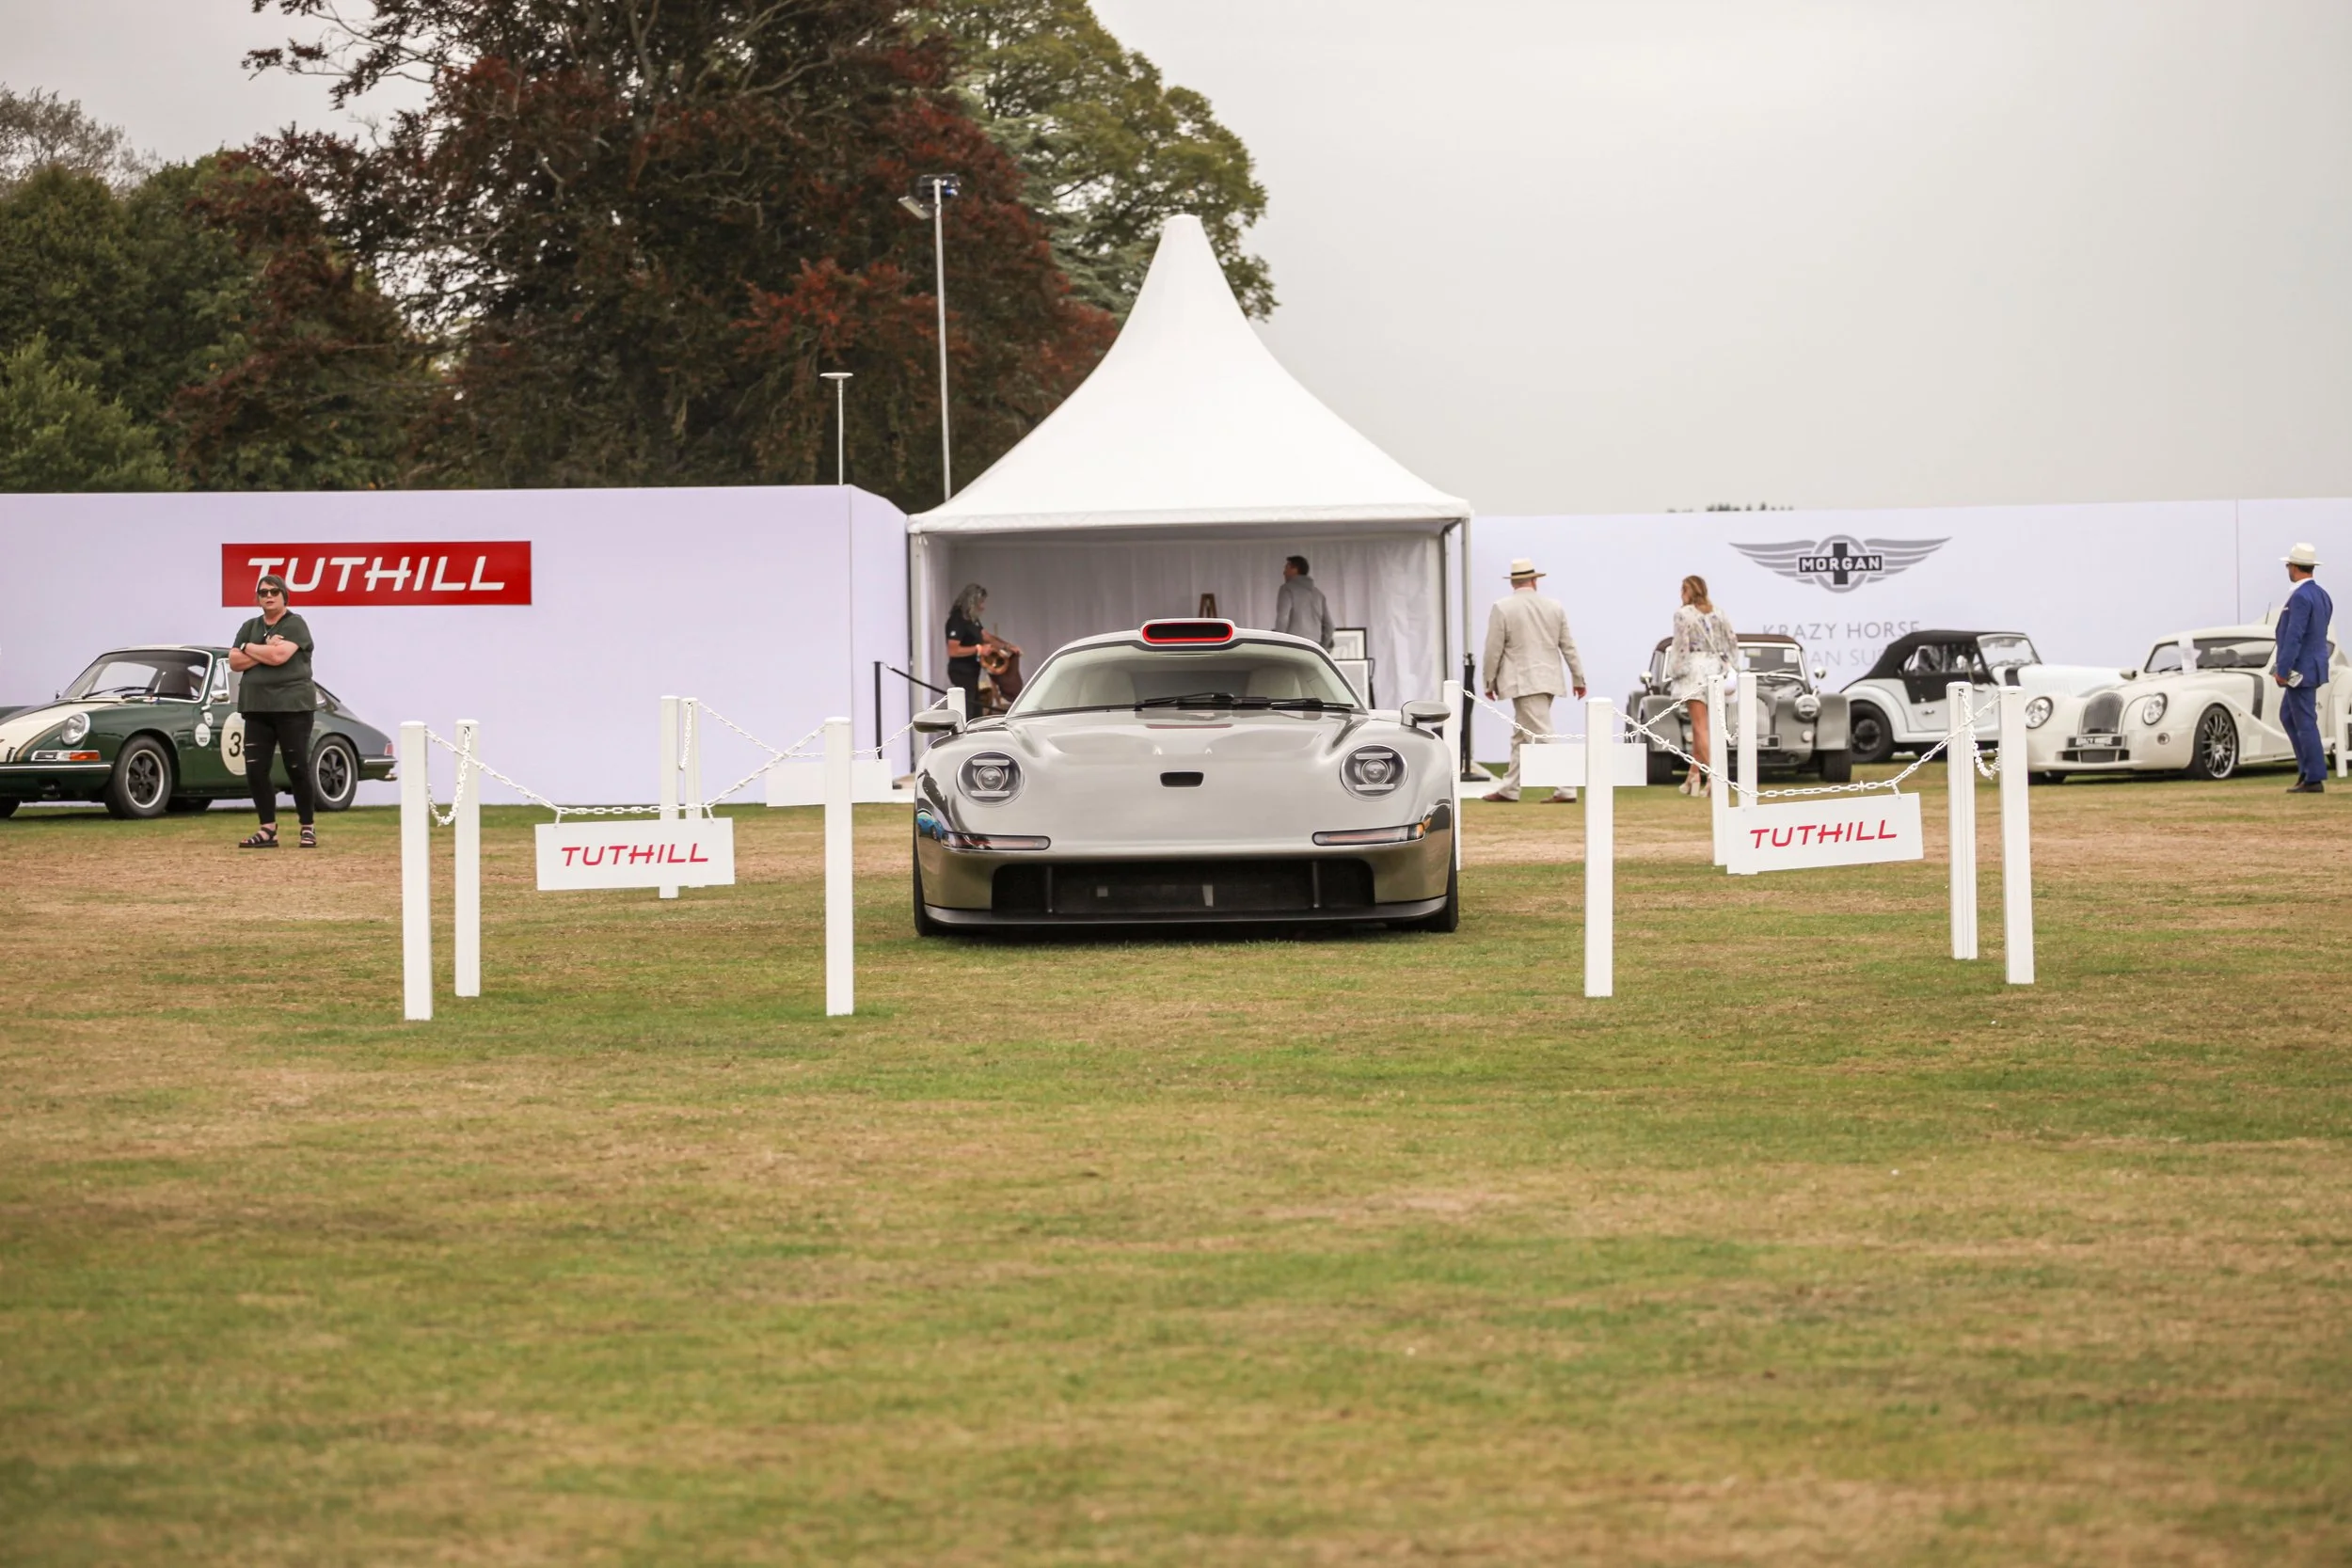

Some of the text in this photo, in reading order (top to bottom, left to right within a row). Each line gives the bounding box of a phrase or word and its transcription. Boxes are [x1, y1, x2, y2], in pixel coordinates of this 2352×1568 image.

[247, 556, 505, 592] TUTHILL
[1801, 557, 1881, 571] MORGAN
[1762, 621, 1920, 641] KRAZY HORSE
[1750, 819, 1898, 848] TUTHILL
[561, 843, 709, 866] TUTHILL
